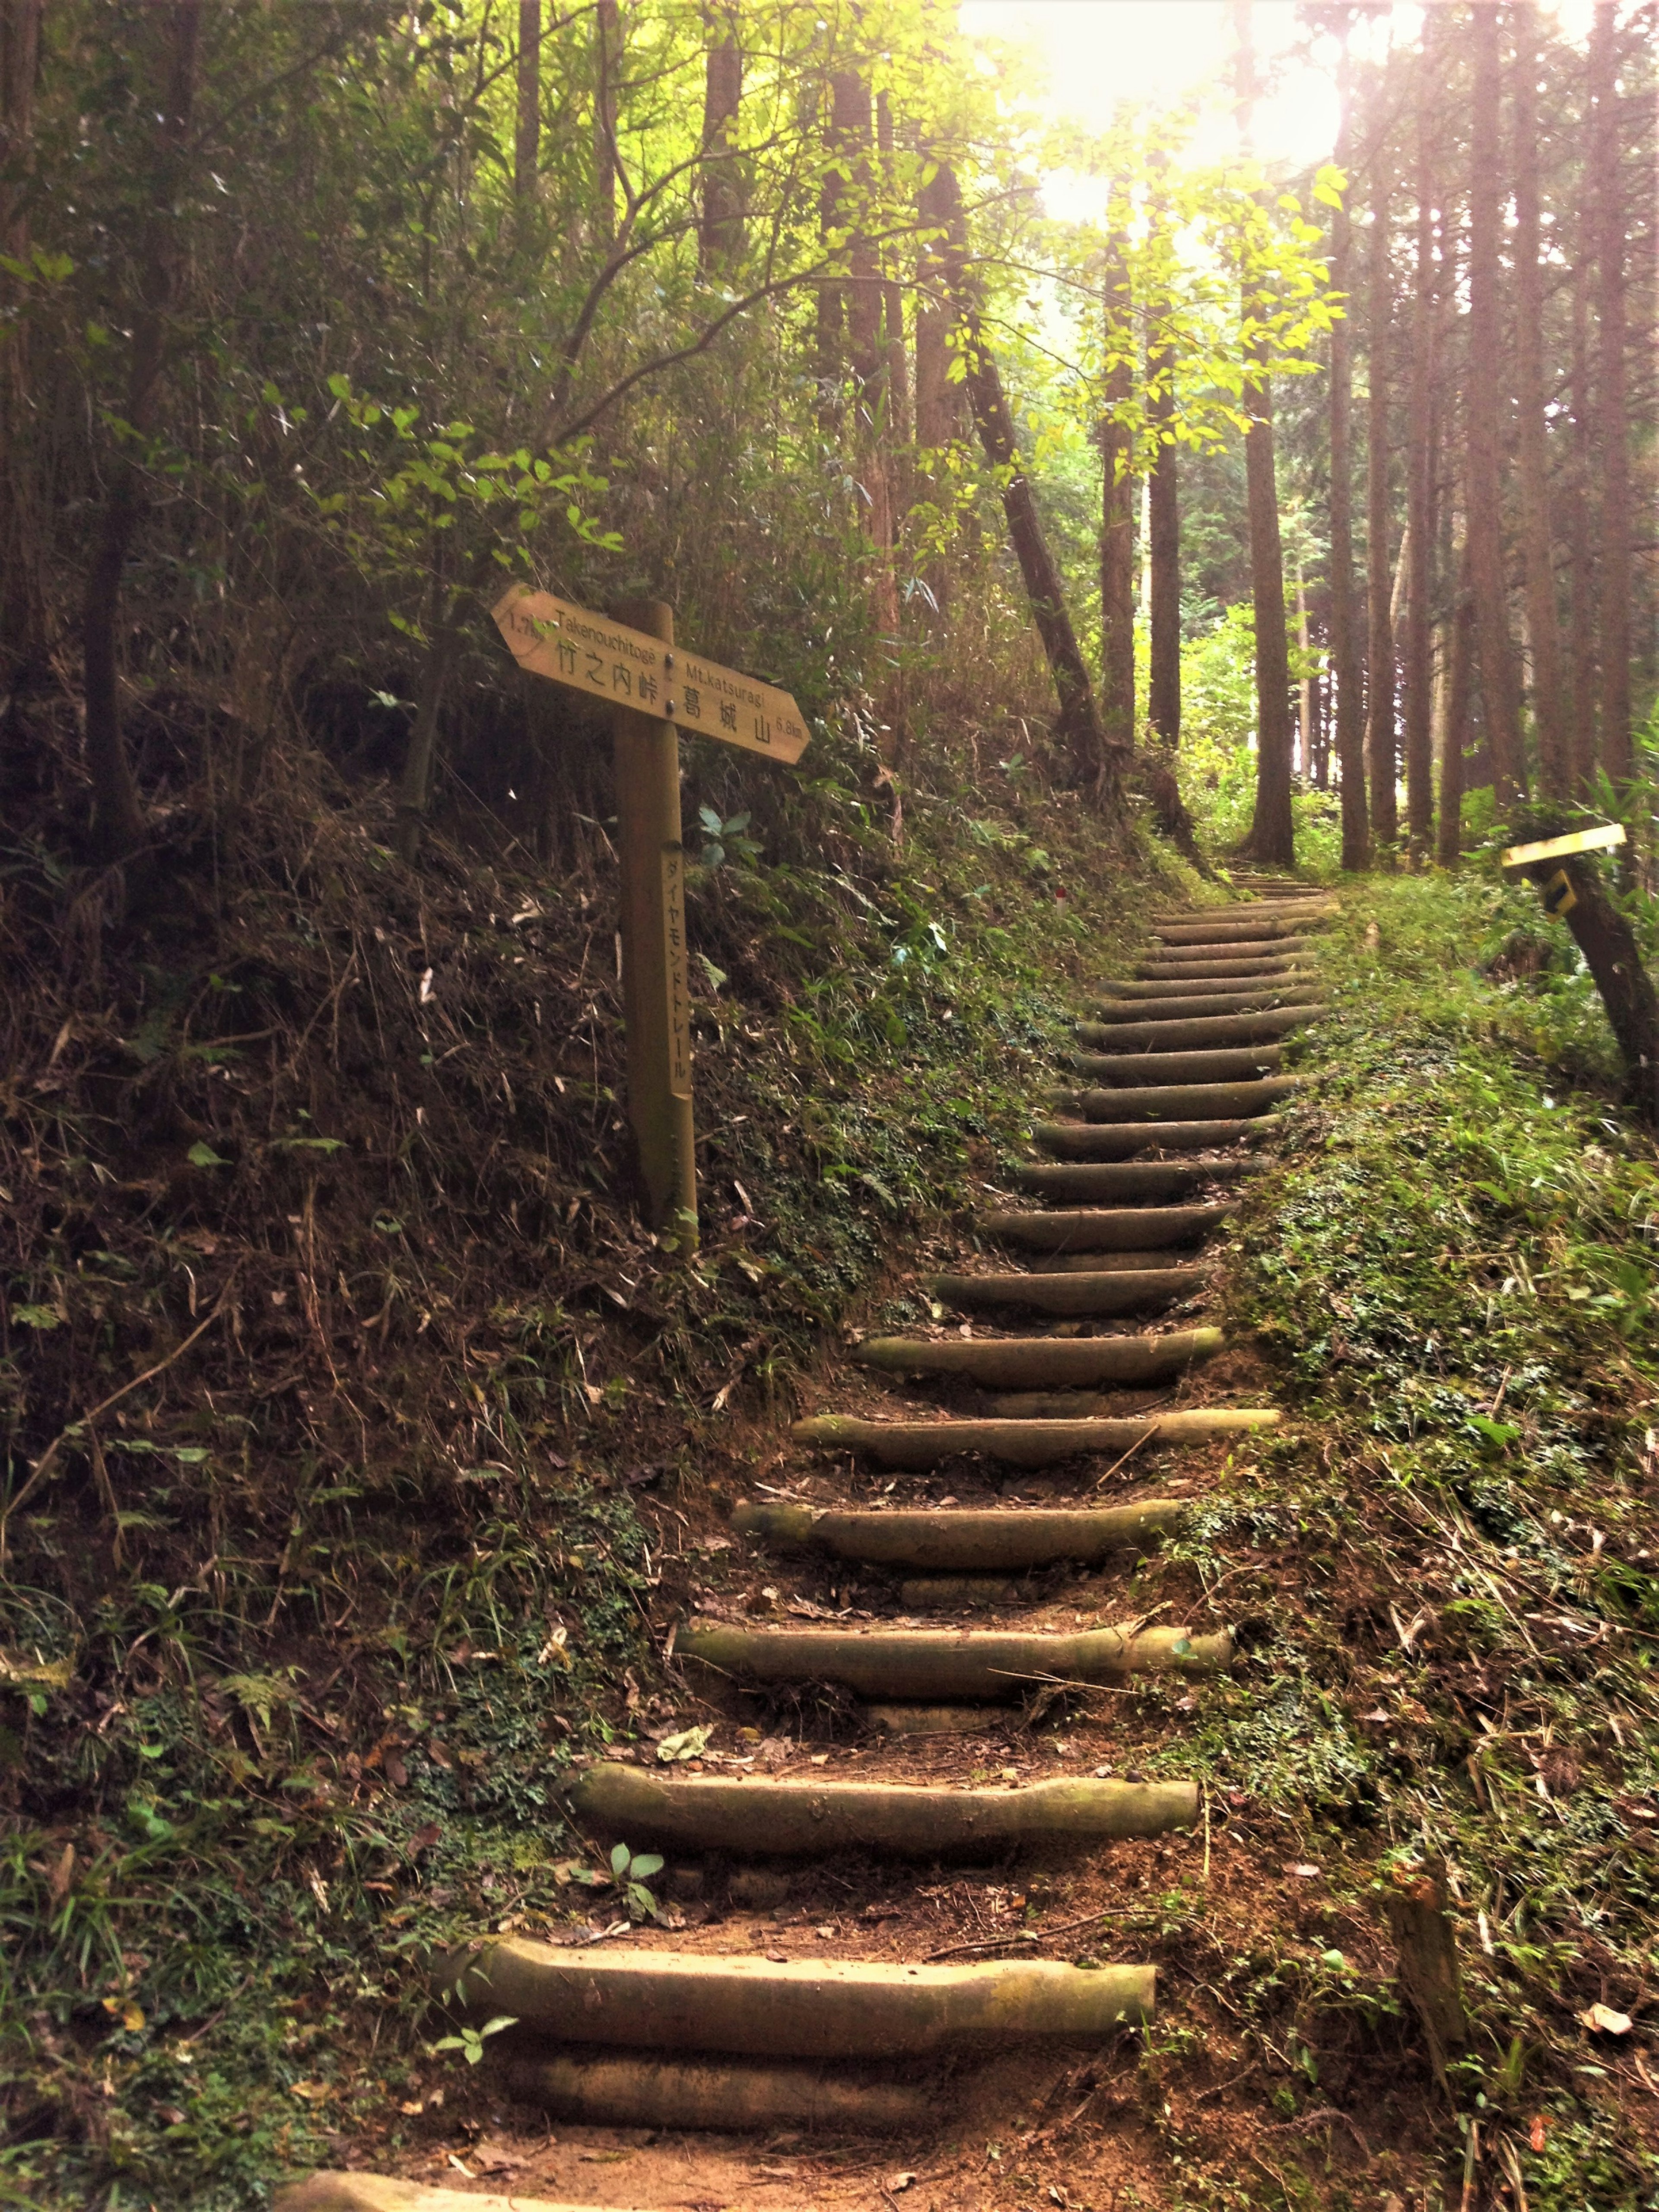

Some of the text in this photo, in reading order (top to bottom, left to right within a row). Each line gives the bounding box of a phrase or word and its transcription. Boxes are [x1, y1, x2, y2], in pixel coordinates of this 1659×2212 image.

[556, 639, 658, 706] 竹之内峠
[682, 684, 770, 744] 葛城山
[667, 860, 686, 1078] ダイヤモンドトレール
